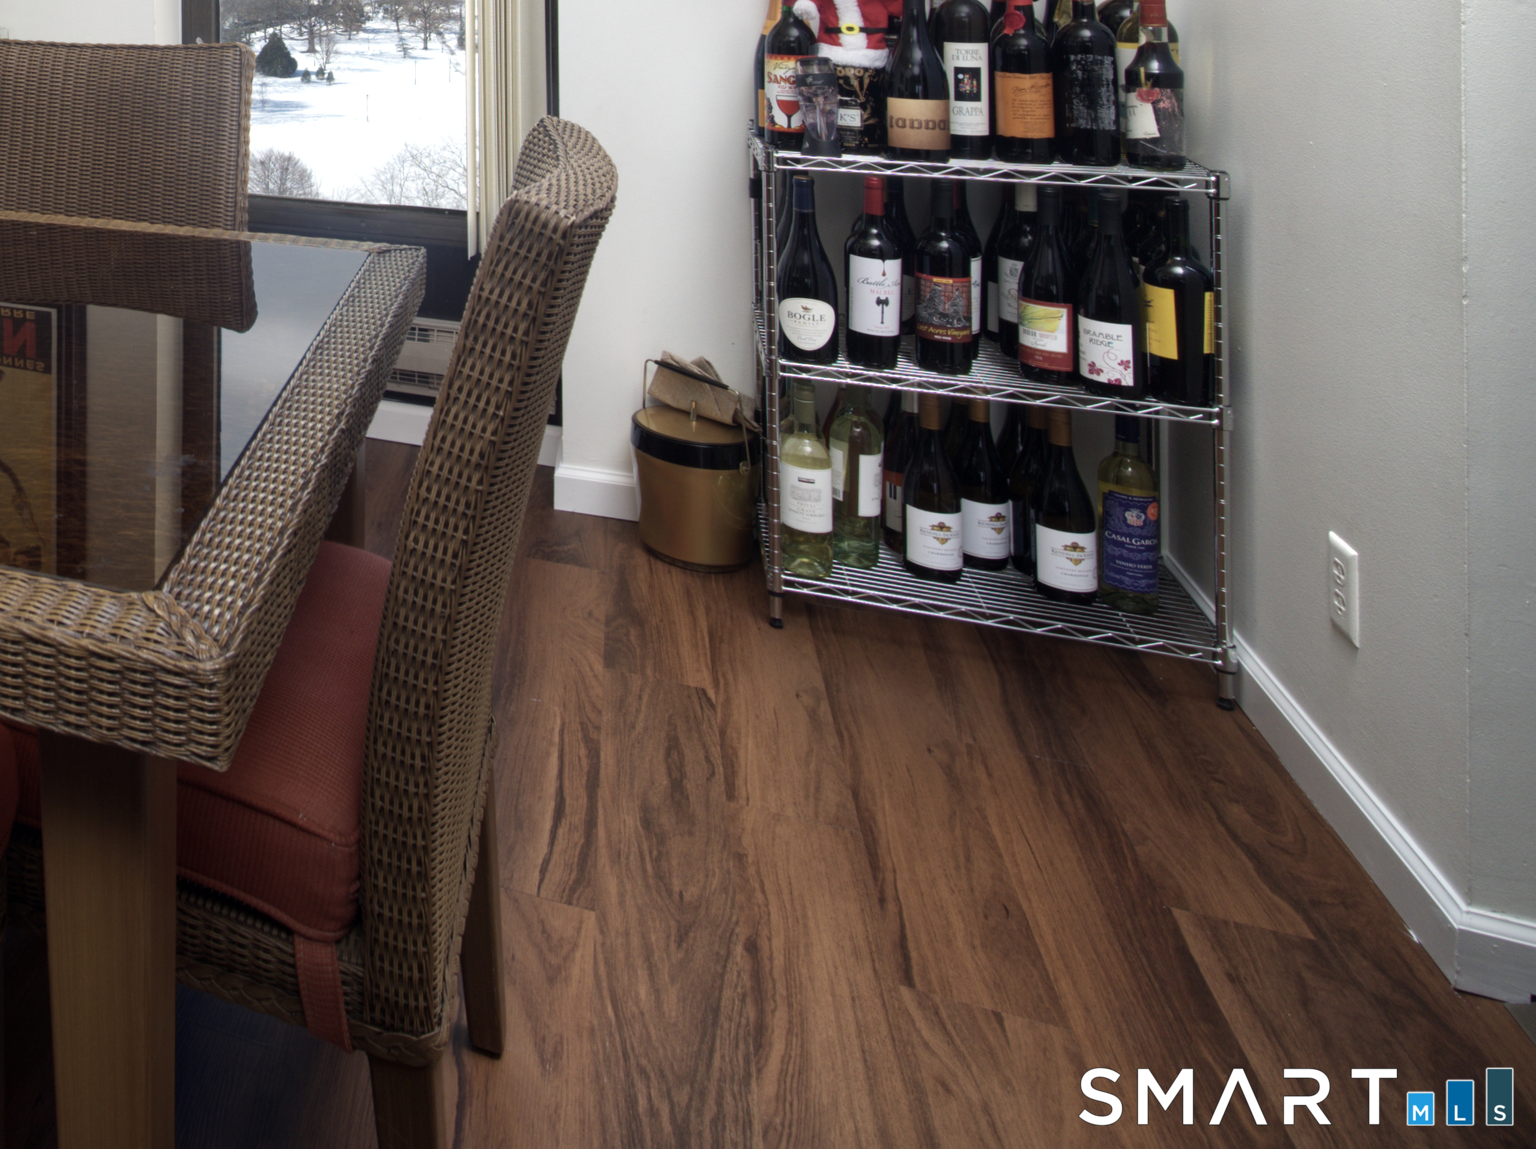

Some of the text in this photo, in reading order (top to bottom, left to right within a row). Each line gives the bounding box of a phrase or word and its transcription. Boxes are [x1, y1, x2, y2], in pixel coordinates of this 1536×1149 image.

[767, 71, 796, 85] SANG
[952, 106, 984, 117] GRAPPA
[889, 115, 949, 131] tanna
[787, 310, 826, 322] BOGLE
[1083, 328, 1123, 341] BRAMBLE
[1089, 337, 1114, 348] RIDGE
[1105, 530, 1132, 543] CASAL
